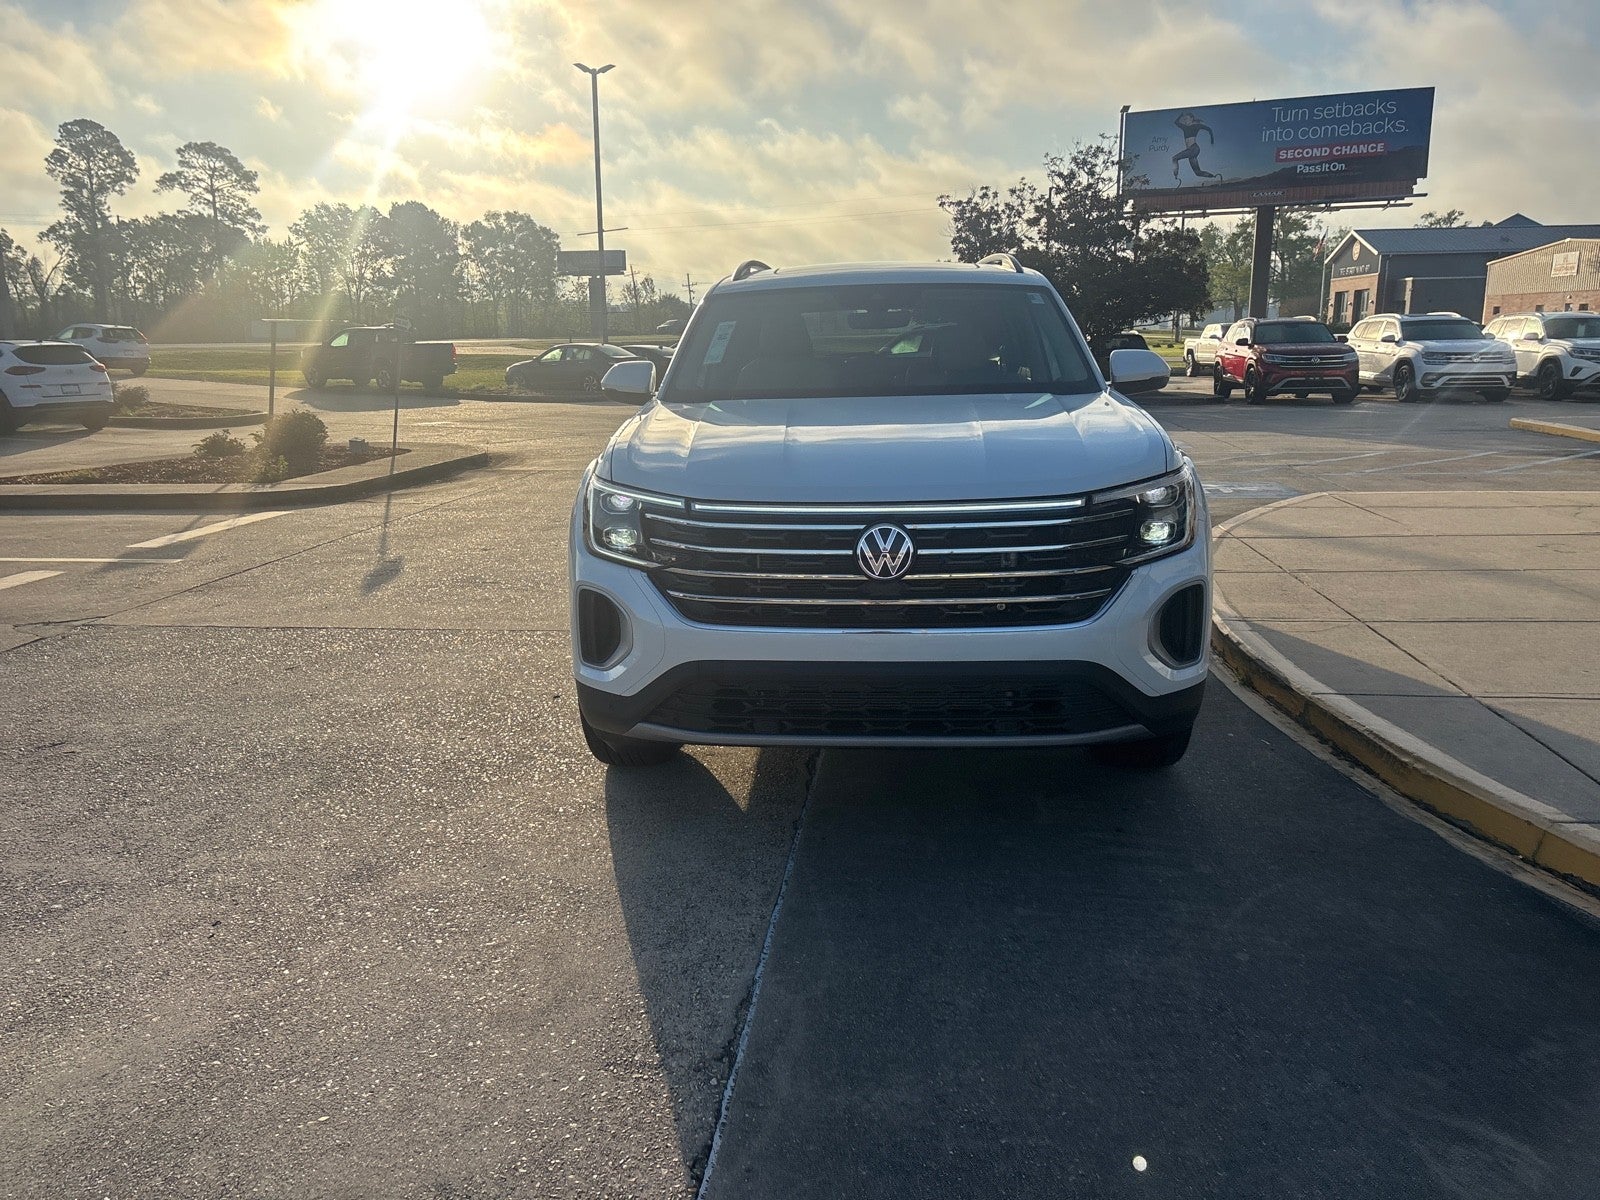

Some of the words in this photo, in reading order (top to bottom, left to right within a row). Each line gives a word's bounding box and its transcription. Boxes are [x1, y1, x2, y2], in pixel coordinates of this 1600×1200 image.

[1272, 106, 1309, 123] Turn
[1313, 99, 1397, 120] setbacks
[1151, 135, 1169, 144] Amy
[1262, 126, 1294, 142] into
[1298, 118, 1409, 140] comebacks.
[1279, 147, 1330, 160] SECOND
[1333, 142, 1385, 156] CHANCE
[858, 525, 912, 578] VW
